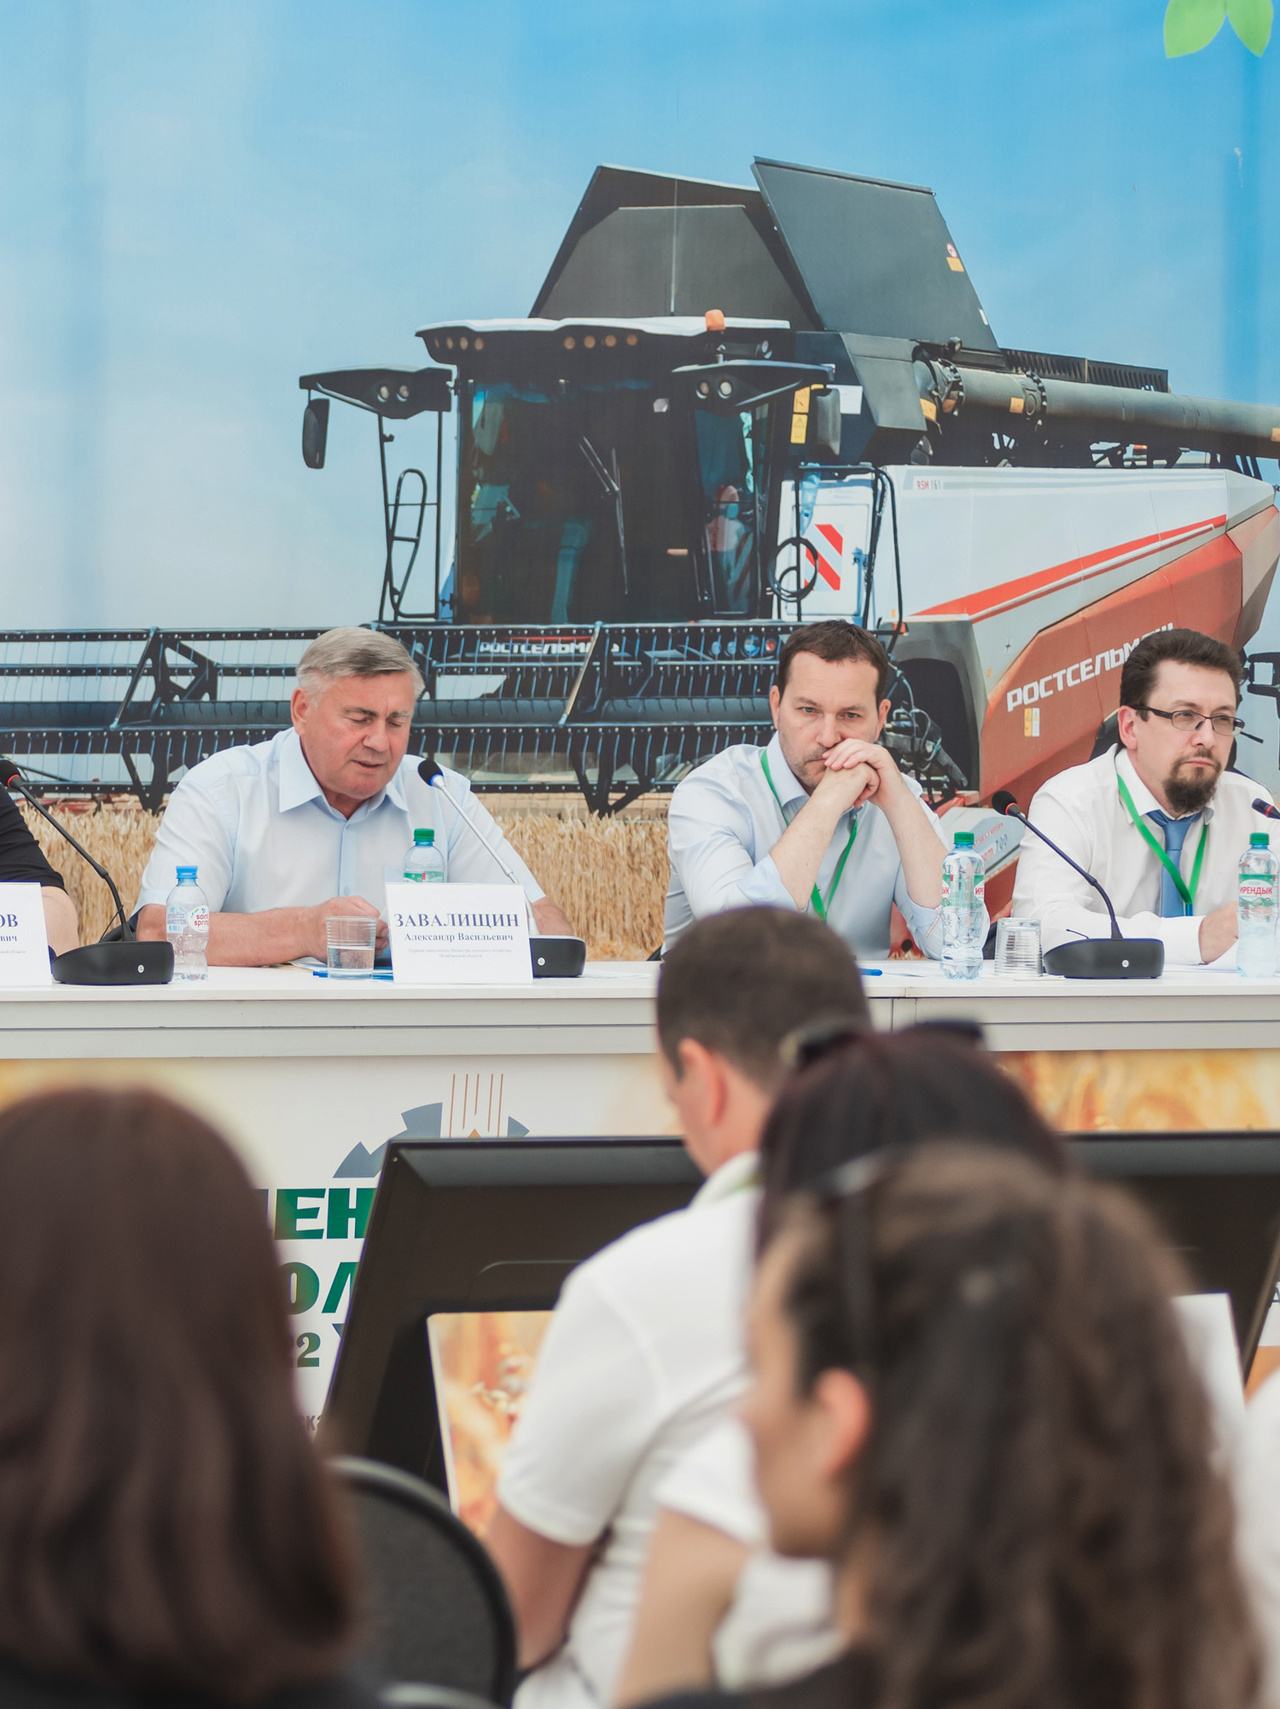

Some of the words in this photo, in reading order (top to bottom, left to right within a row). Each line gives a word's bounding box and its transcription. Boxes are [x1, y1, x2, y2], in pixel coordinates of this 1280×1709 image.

[1007, 622, 1174, 712] РОСТСЕЛЬМ
[394, 913, 520, 929] ЗАВАЛИЩИН
[404, 933, 455, 942] Александр
[458, 932, 514, 941] Васильевич
